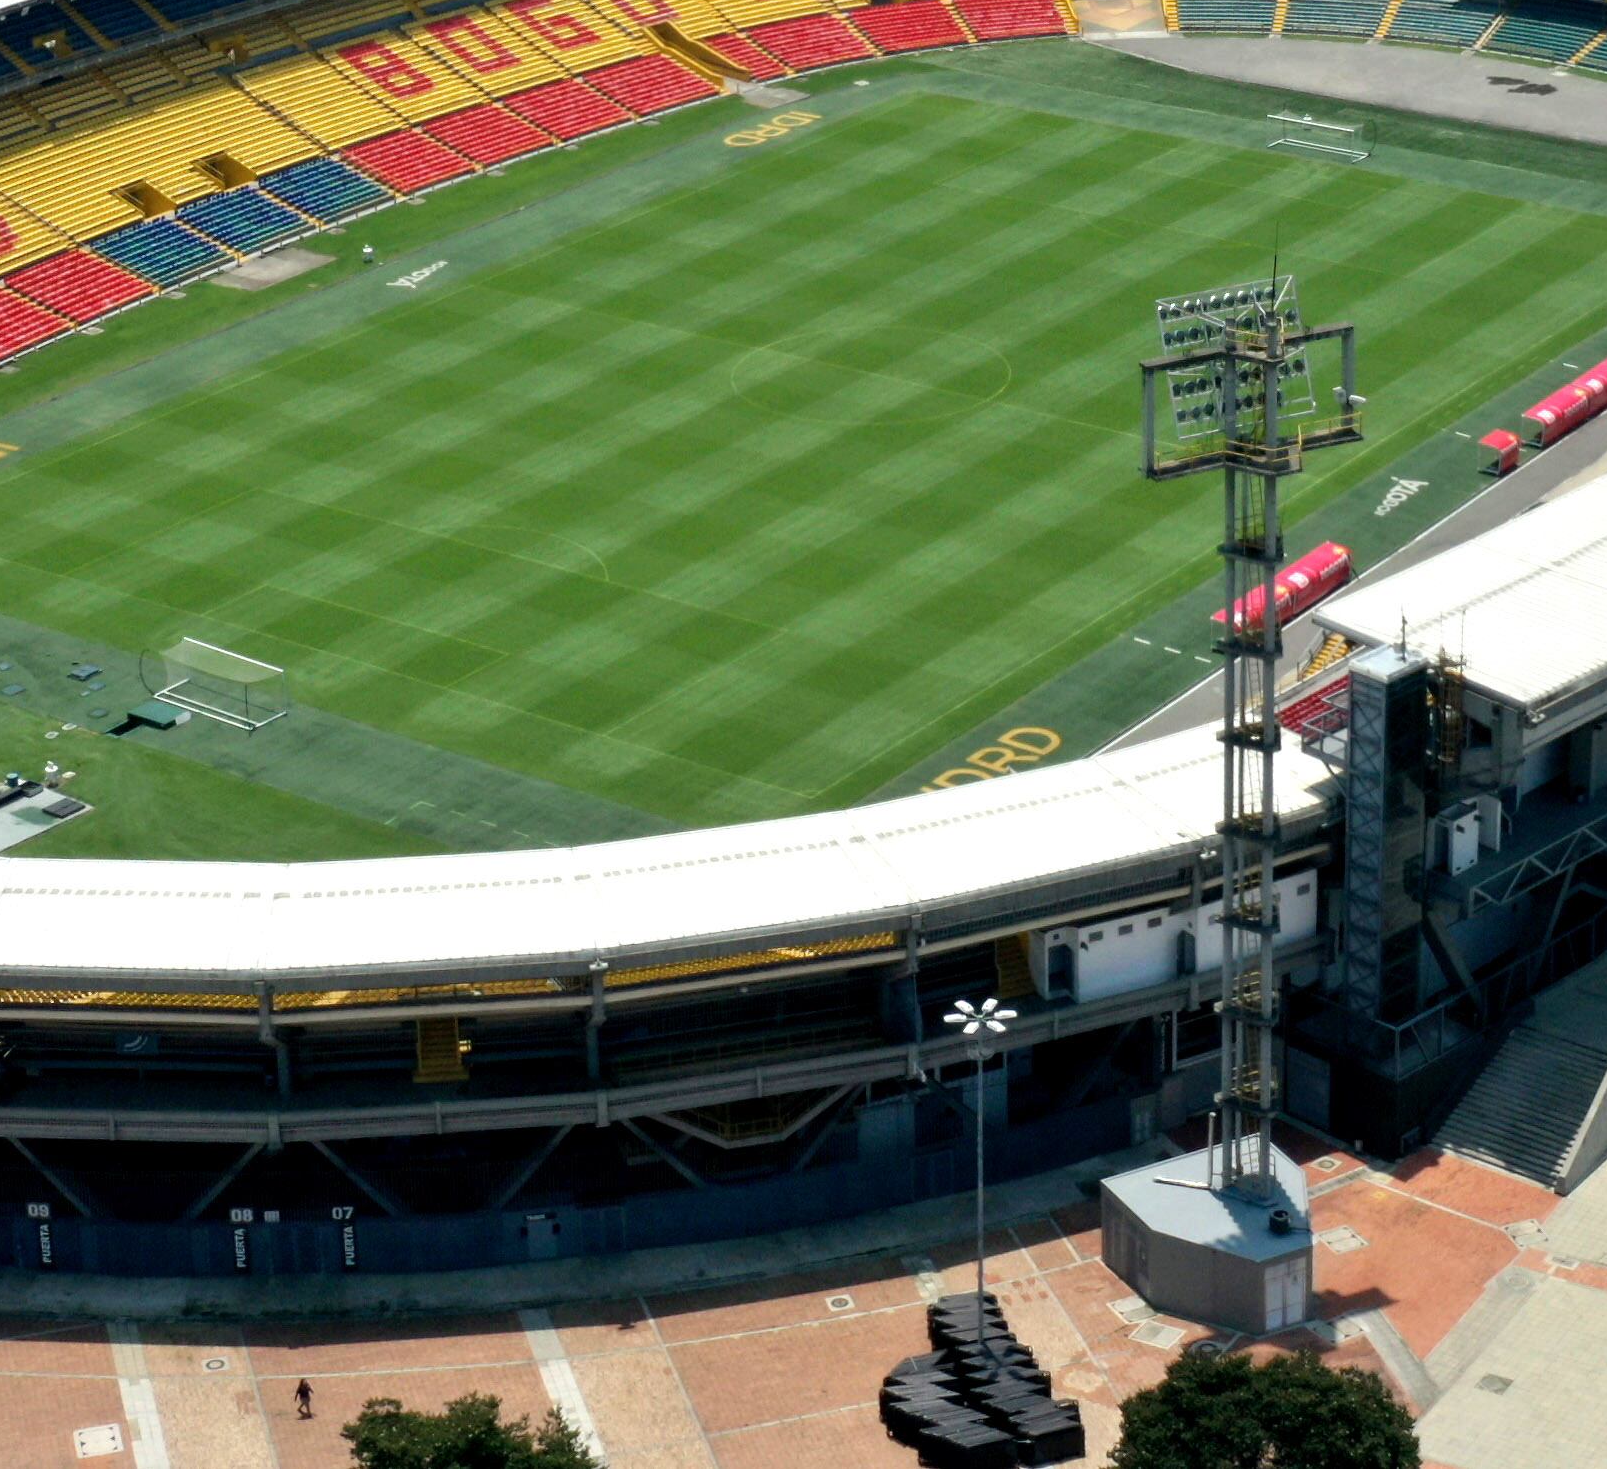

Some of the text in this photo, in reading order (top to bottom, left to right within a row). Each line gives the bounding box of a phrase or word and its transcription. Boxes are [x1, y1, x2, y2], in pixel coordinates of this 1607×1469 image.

[724, 110, 823, 147] IDRD
[919, 726, 1063, 793] DRD
[28, 1204, 50, 1218] 09
[230, 1209, 254, 1223] 08
[332, 1206, 354, 1220] 07
[40, 1224, 52, 1263] PUERTA
[234, 1228, 247, 1268] PUERTA
[343, 1226, 355, 1266] PUERTA
